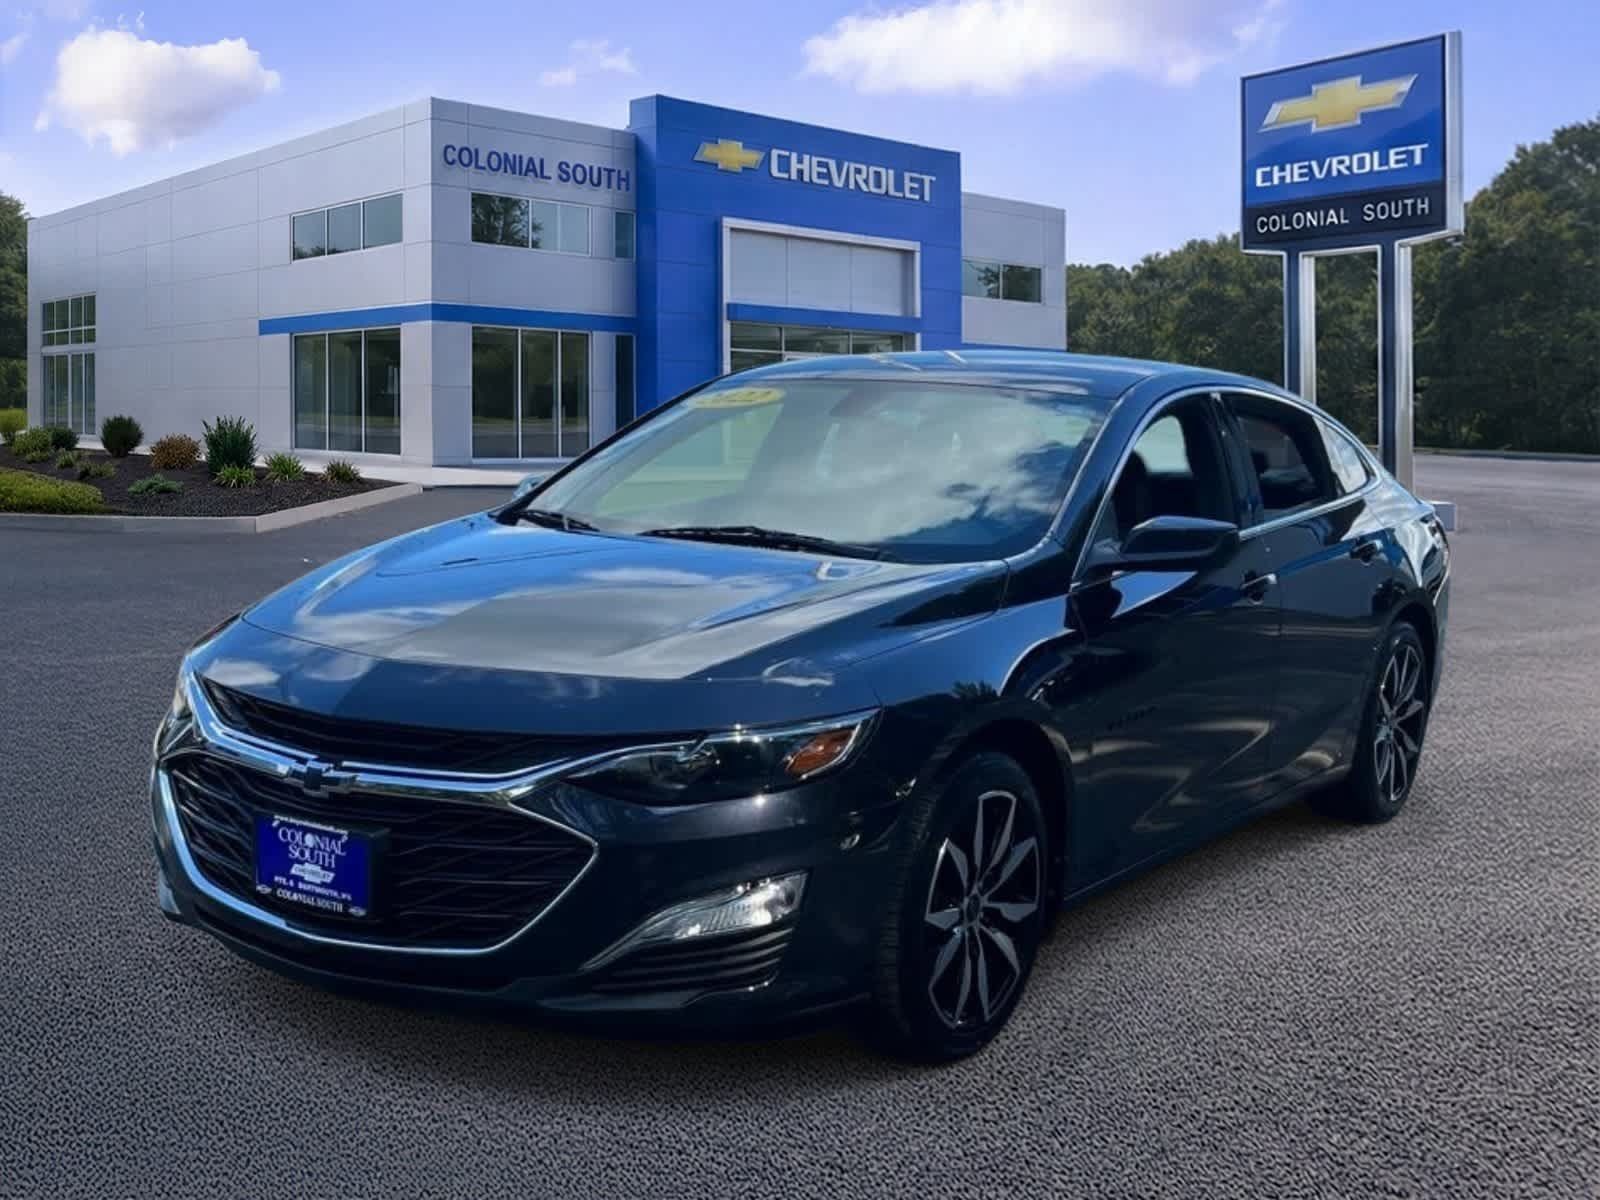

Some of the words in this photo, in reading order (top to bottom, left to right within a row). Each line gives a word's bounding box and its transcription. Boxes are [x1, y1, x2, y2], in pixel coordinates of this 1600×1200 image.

[443, 144, 552, 181] COLONIAL
[557, 161, 630, 192] SOUTH
[769, 148, 937, 202] CHEVROLET
[1255, 143, 1429, 188] CHEVROLET
[1256, 207, 1349, 233] COLONIAL
[1362, 196, 1430, 222] SOUTH
[278, 827, 346, 856] COLONIAL
[288, 845, 336, 868] SOUTH
